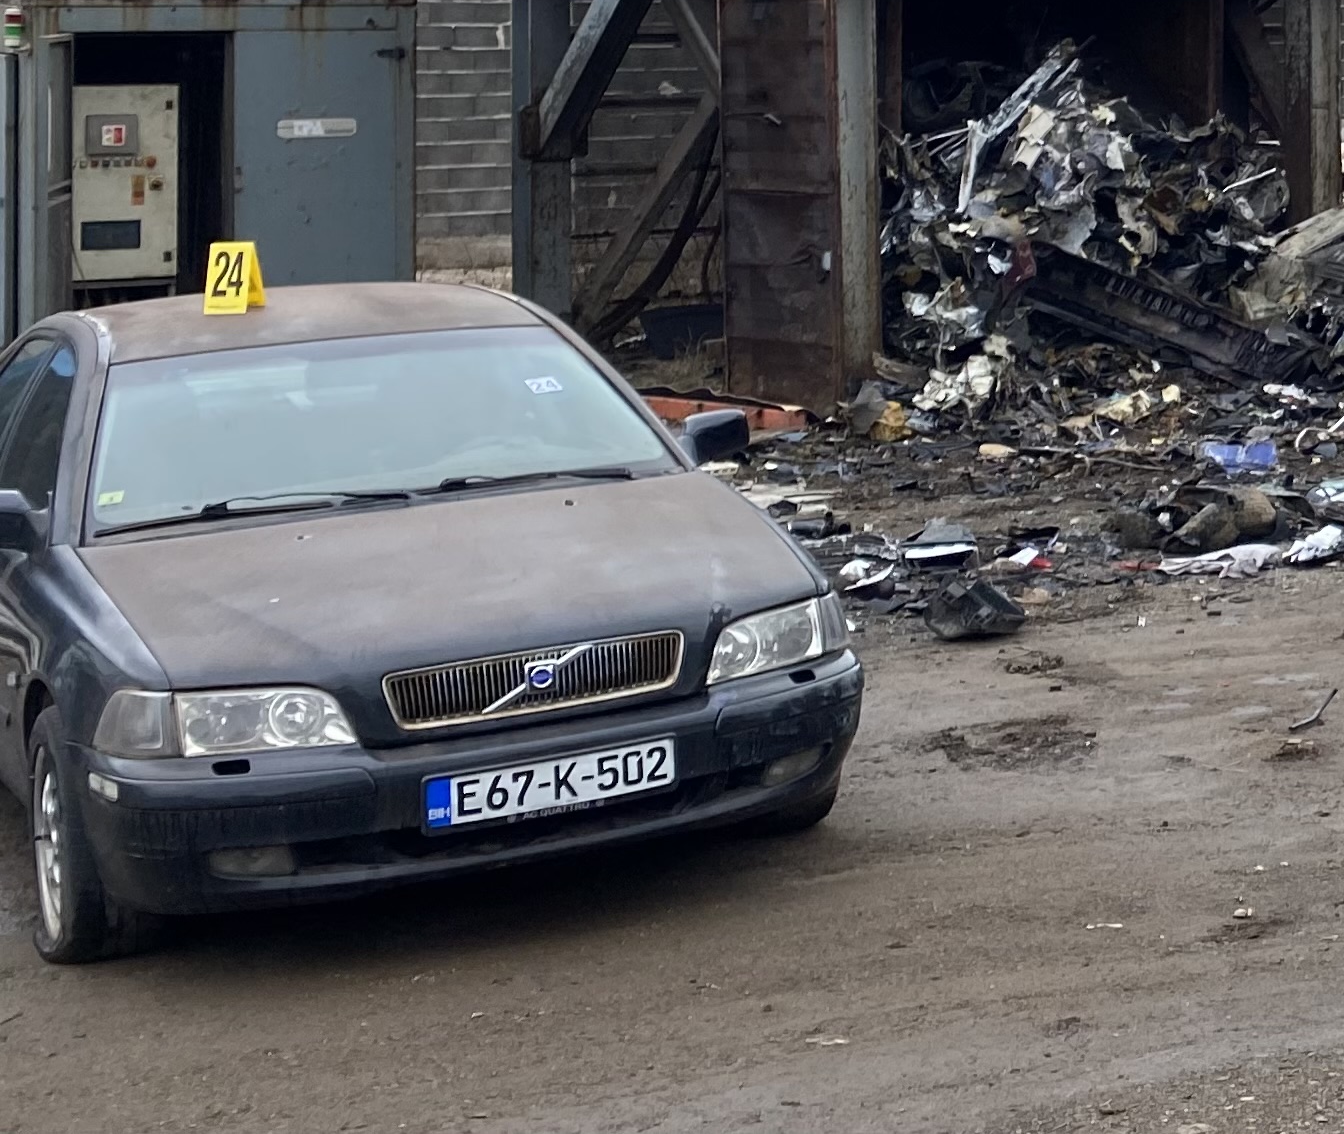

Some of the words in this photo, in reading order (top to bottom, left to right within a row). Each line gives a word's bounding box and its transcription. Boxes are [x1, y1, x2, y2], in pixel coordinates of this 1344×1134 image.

[211, 251, 244, 297] 24
[456, 746, 668, 818] E67-K-502
[428, 806, 451, 821] BIH
